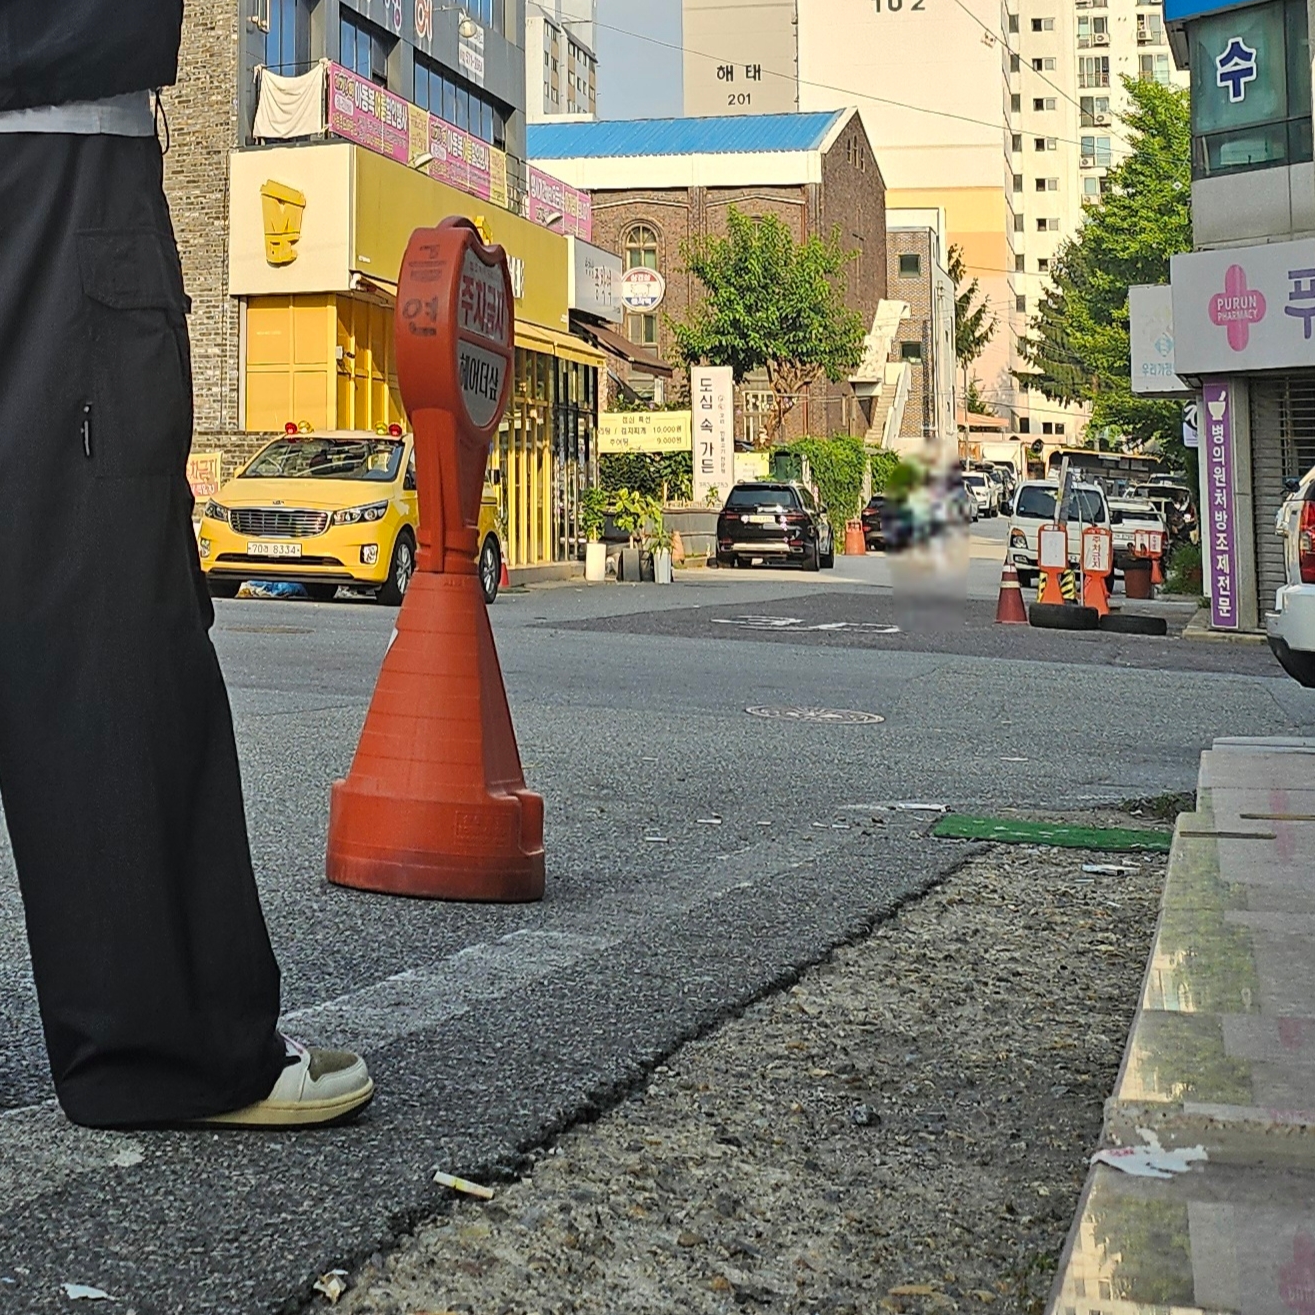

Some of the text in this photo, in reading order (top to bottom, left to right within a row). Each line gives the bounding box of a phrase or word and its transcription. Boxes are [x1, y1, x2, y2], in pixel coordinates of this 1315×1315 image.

[716, 62, 762, 83] 해태
[1217, 37, 1258, 103] 수
[727, 93, 752, 107] 201
[461, 274, 506, 340] 주차금지
[1216, 295, 1257, 311] PURUN
[1217, 308, 1258, 321] PHARMACY
